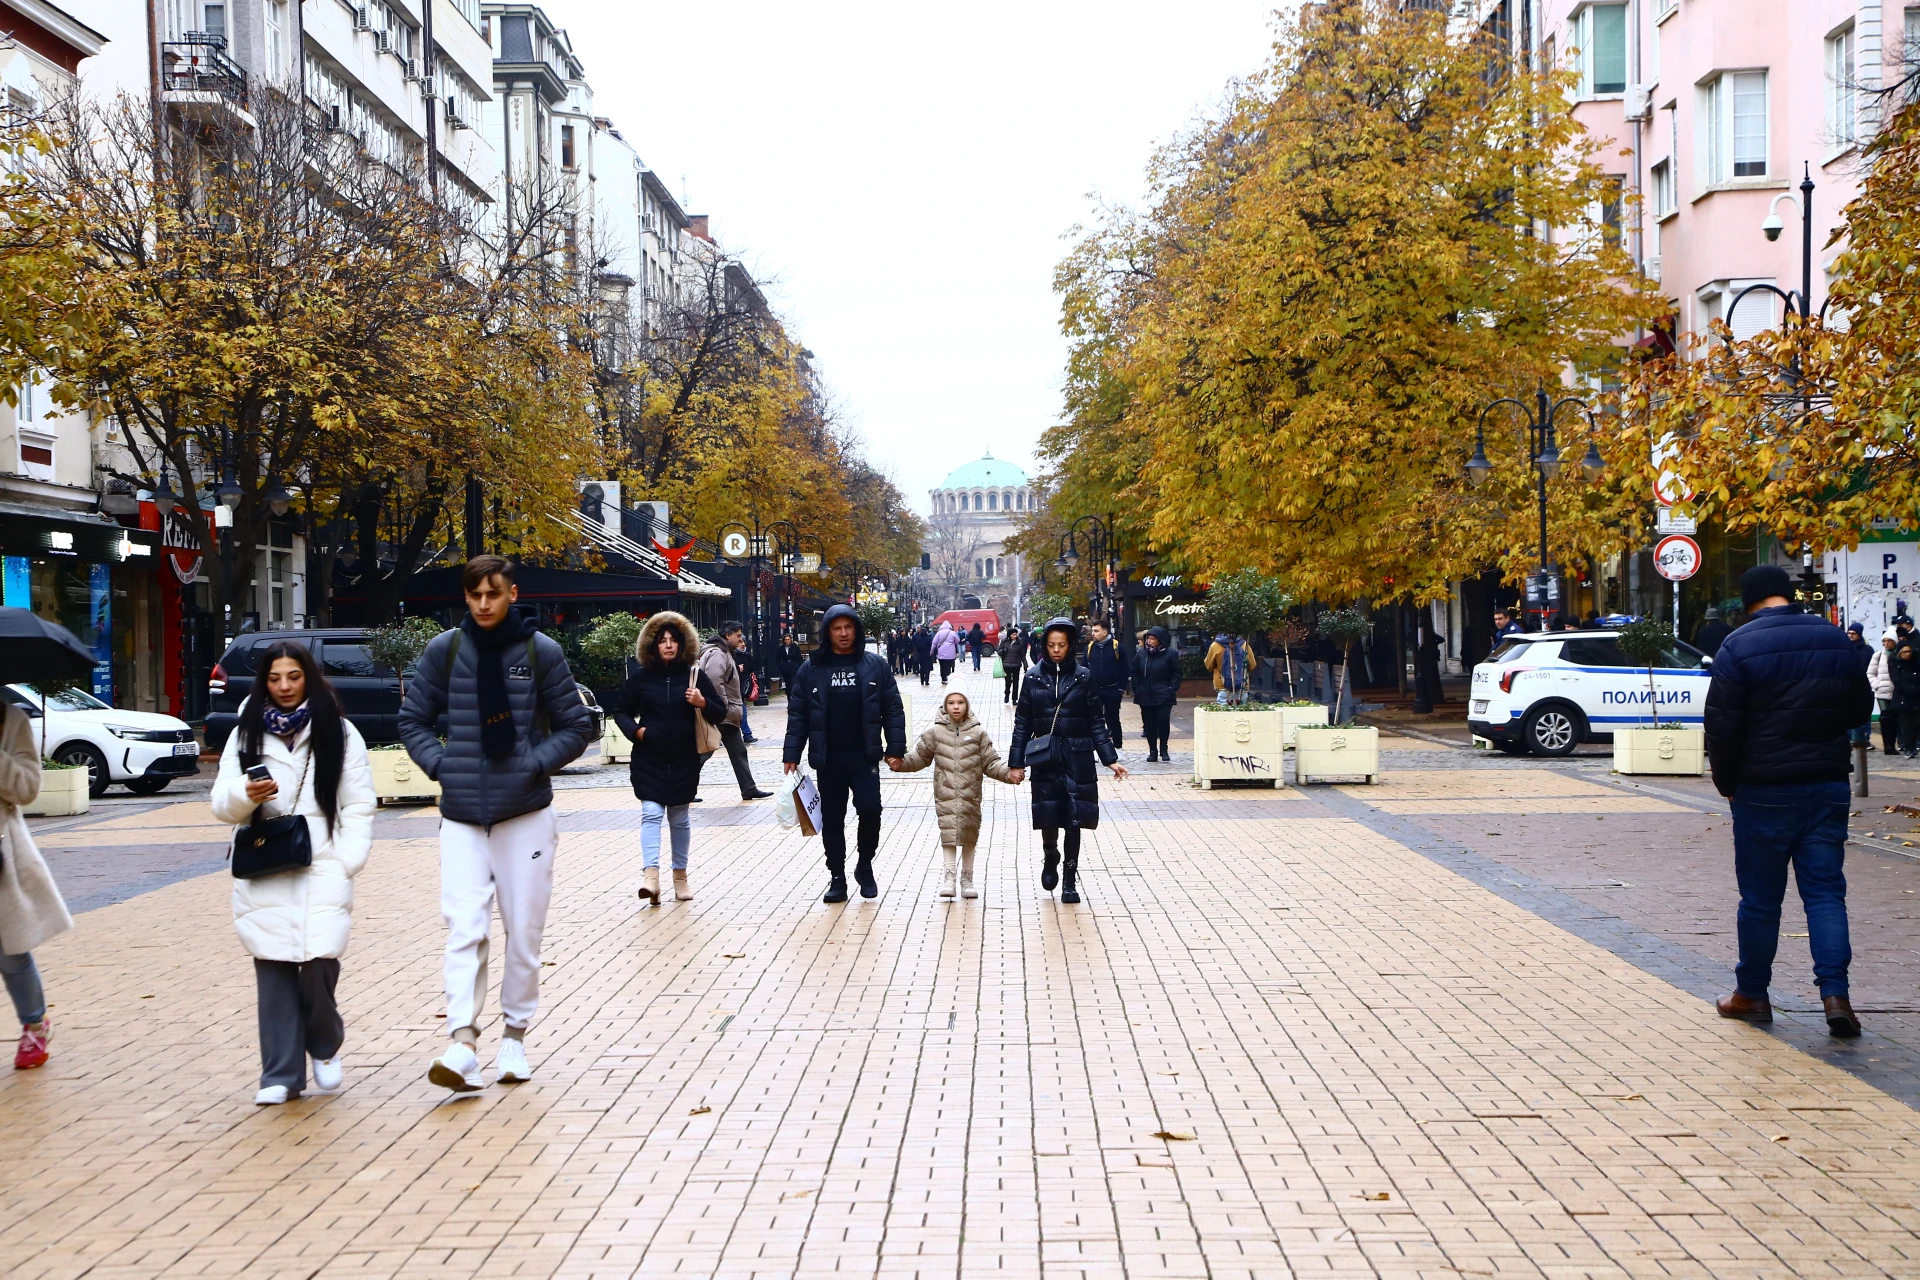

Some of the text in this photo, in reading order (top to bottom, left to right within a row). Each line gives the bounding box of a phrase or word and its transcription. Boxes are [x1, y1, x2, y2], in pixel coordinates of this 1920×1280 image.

[731, 538, 741, 550] R
[831, 671, 847, 680] AIR
[1523, 672, 1551, 680] 24-1501
[831, 678, 857, 687] MAX
[1602, 690, 1691, 705] ПОЛИЦИЯ
[807, 794, 820, 814] BOSS
